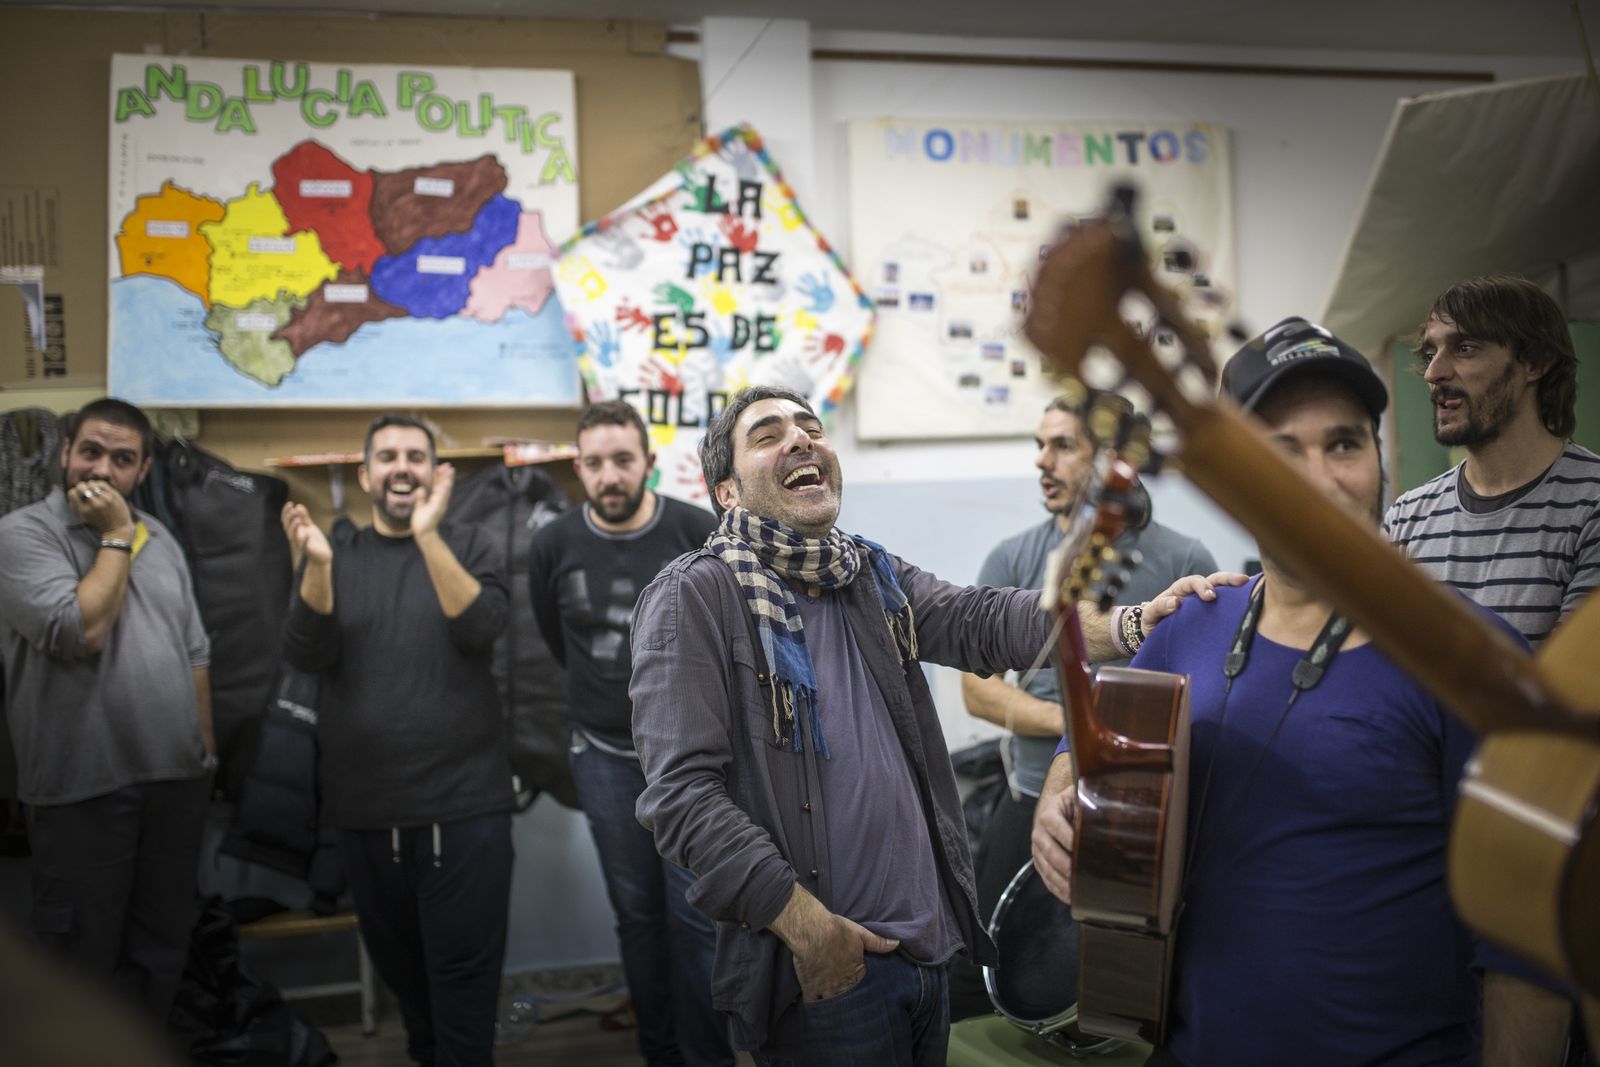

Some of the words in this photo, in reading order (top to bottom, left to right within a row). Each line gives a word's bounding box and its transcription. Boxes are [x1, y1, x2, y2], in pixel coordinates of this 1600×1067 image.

[115, 60, 387, 134] ANDALUCIA
[397, 71, 577, 183] POLITICA
[884, 128, 1208, 168] MONUMENTOS
[704, 174, 764, 219] LA
[686, 243, 781, 285] PAZ
[654, 313, 710, 351] ES
[731, 314, 779, 351] DE
